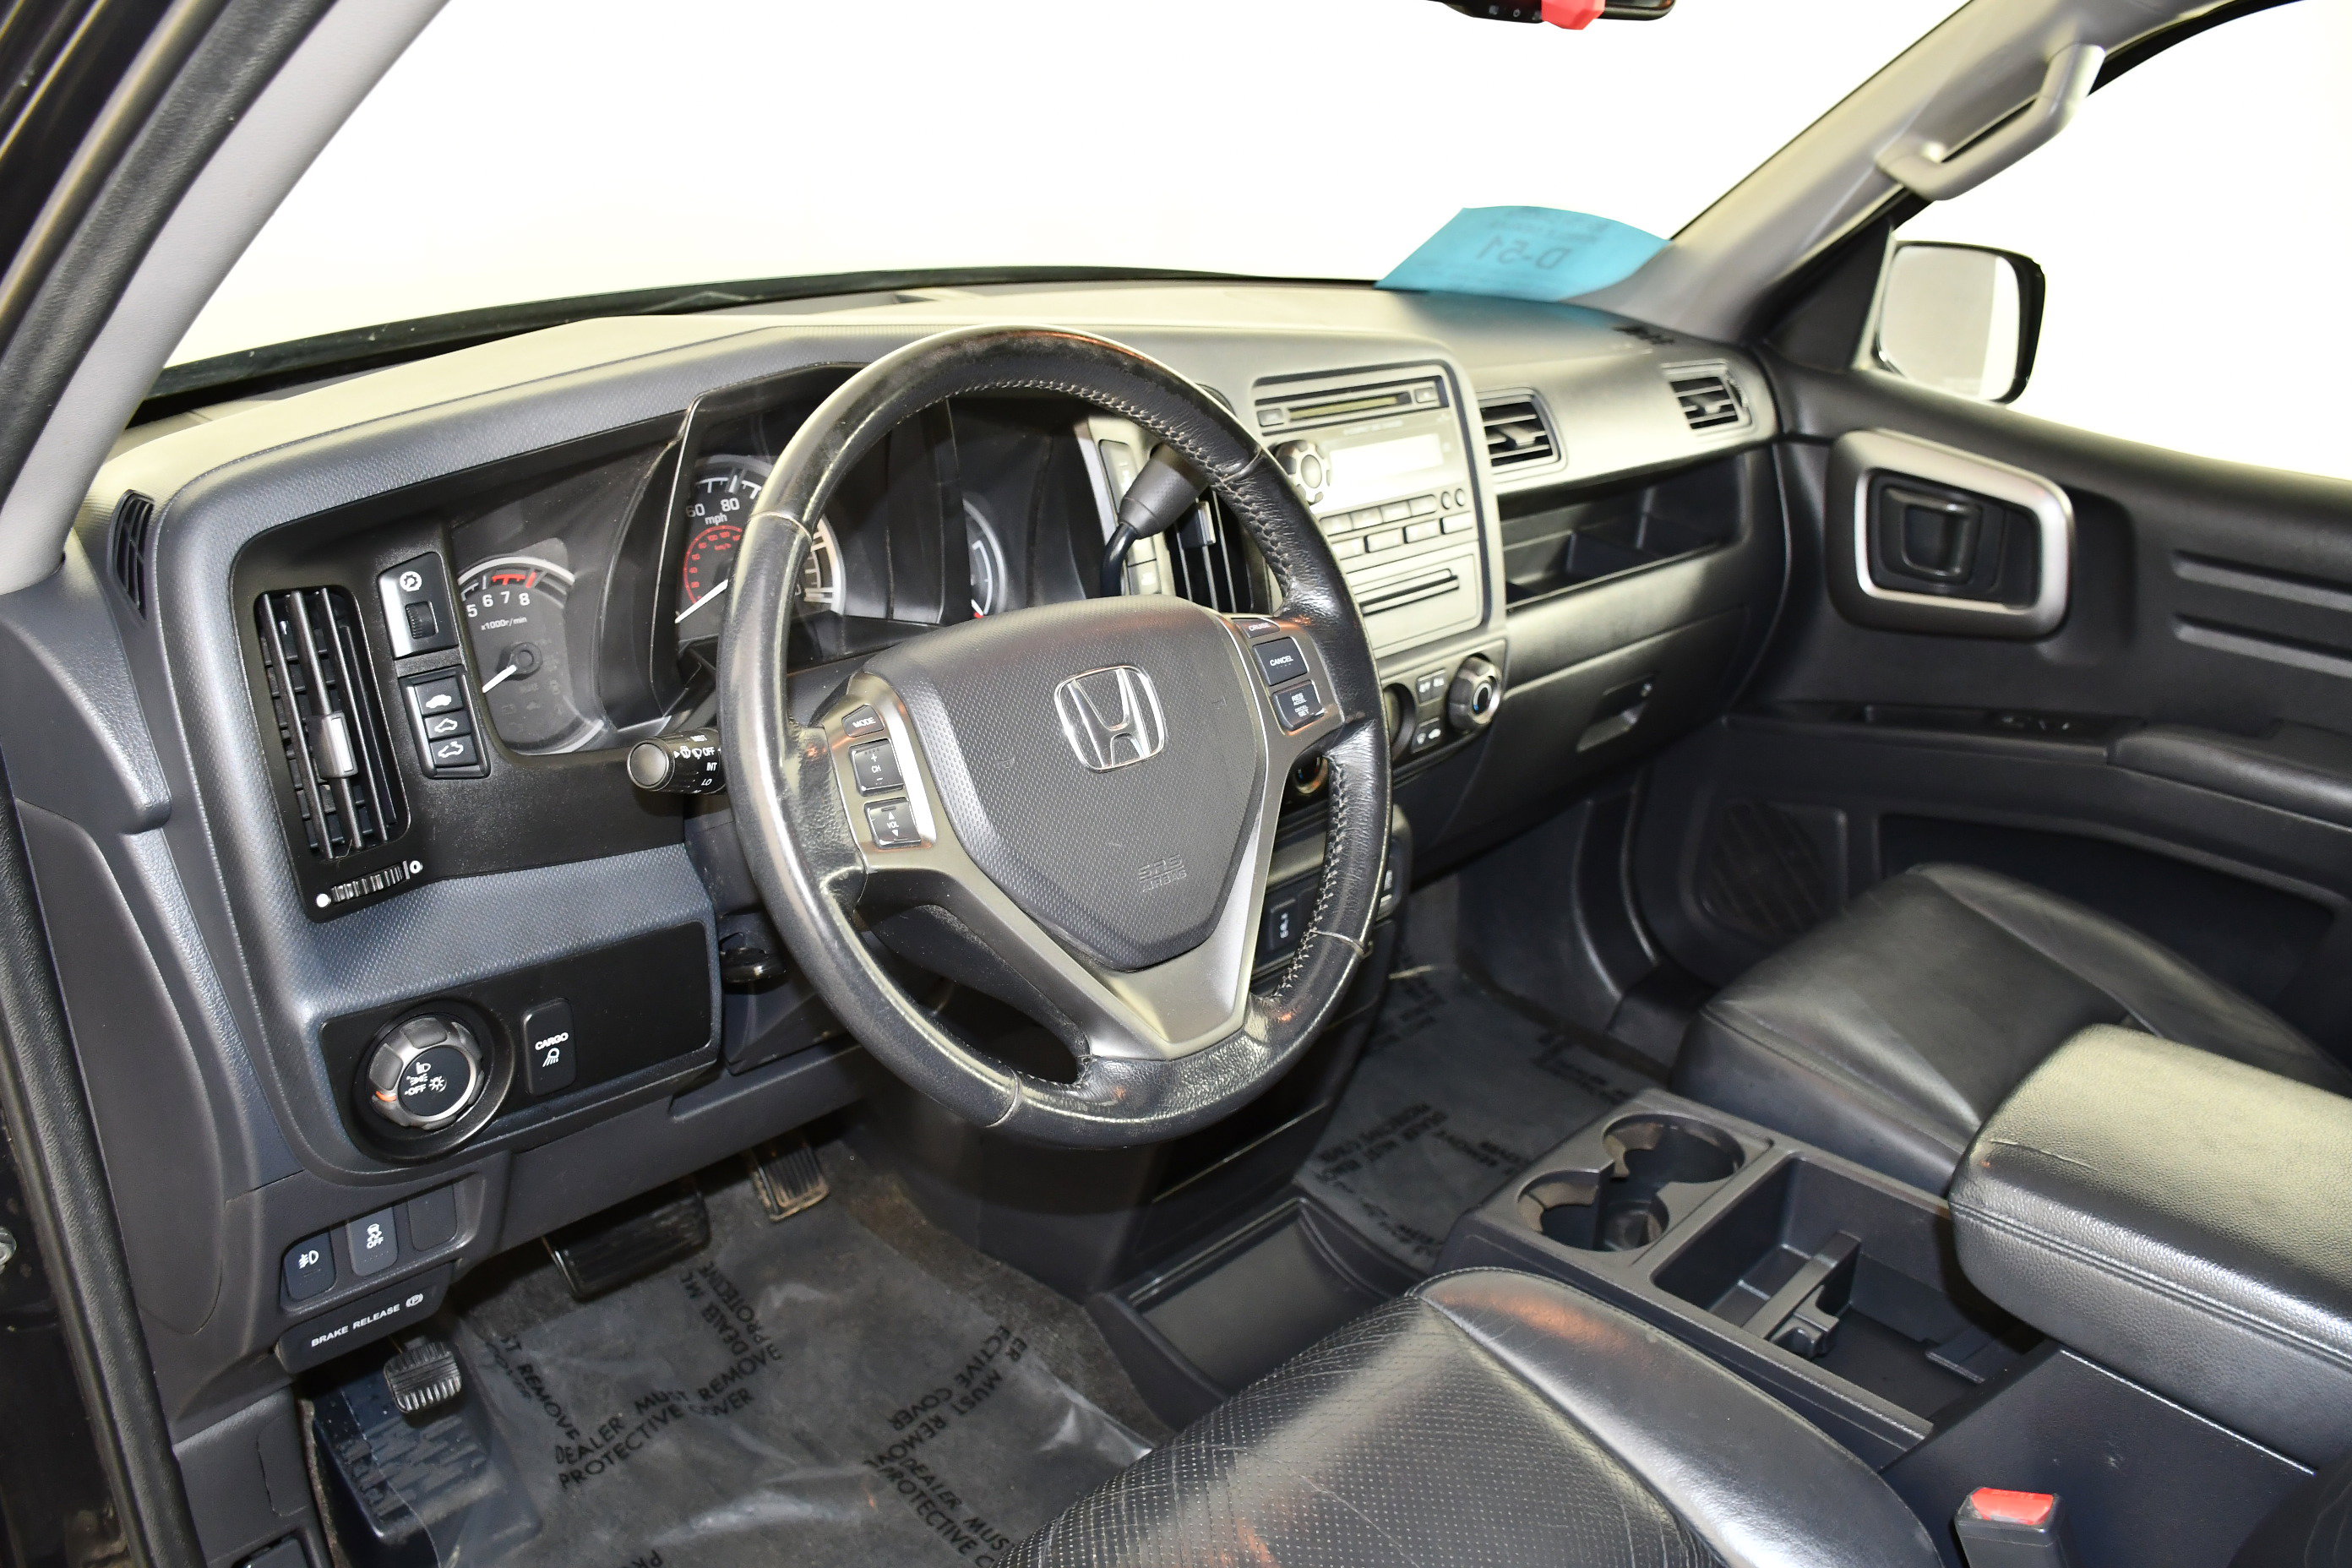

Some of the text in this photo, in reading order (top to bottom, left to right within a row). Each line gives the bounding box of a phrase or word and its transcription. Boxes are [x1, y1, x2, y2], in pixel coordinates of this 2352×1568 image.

[686, 497, 740, 517] 60 80
[705, 513, 728, 526] mph
[466, 591, 531, 618] 5 6 7 8
[1269, 655, 1294, 667] CANCEL
[1291, 692, 1304, 702] RES
[852, 716, 877, 728] MODE
[702, 746, 716, 757] OFF
[705, 761, 718, 771] INT
[871, 765, 882, 774] CH
[700, 778, 713, 787] LO
[886, 819, 900, 830] VOL
[535, 1032, 569, 1051] CARGO
[408, 1083, 427, 1097] OFF
[366, 1236, 384, 1250] OFF
[311, 1304, 400, 1348] BRAKE RELEASE
[950, 1369, 1003, 1416] MUST
[517, 1363, 580, 1440] REMOVE
[889, 1387, 953, 1431] COVER
[555, 1417, 626, 1466] DEALER
[558, 1386, 755, 1491] PROTECTIVE VER
[900, 1458, 963, 1511] DEALER
